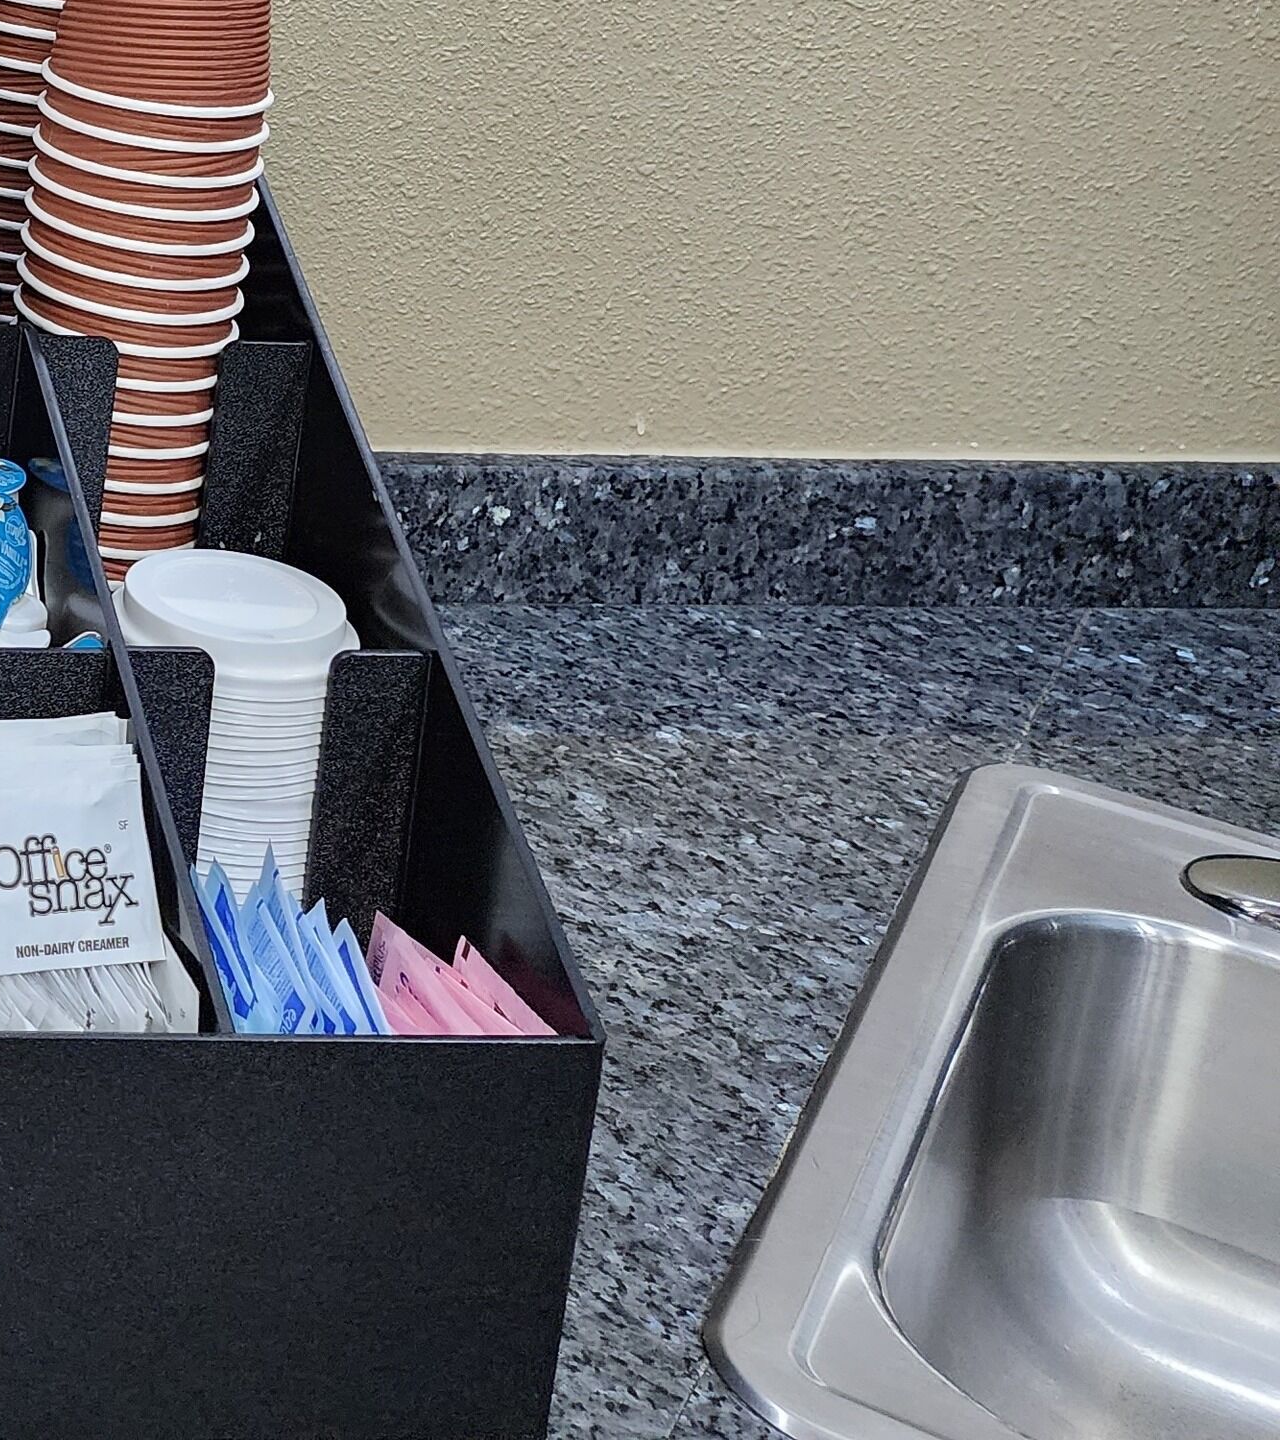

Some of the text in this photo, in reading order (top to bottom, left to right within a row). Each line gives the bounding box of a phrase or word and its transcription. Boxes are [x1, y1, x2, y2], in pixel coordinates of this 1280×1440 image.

[118, 820, 128, 830] SF
[28, 875, 139, 926] snax
[16, 936, 130, 958] NON-DAIRY CREAMER
